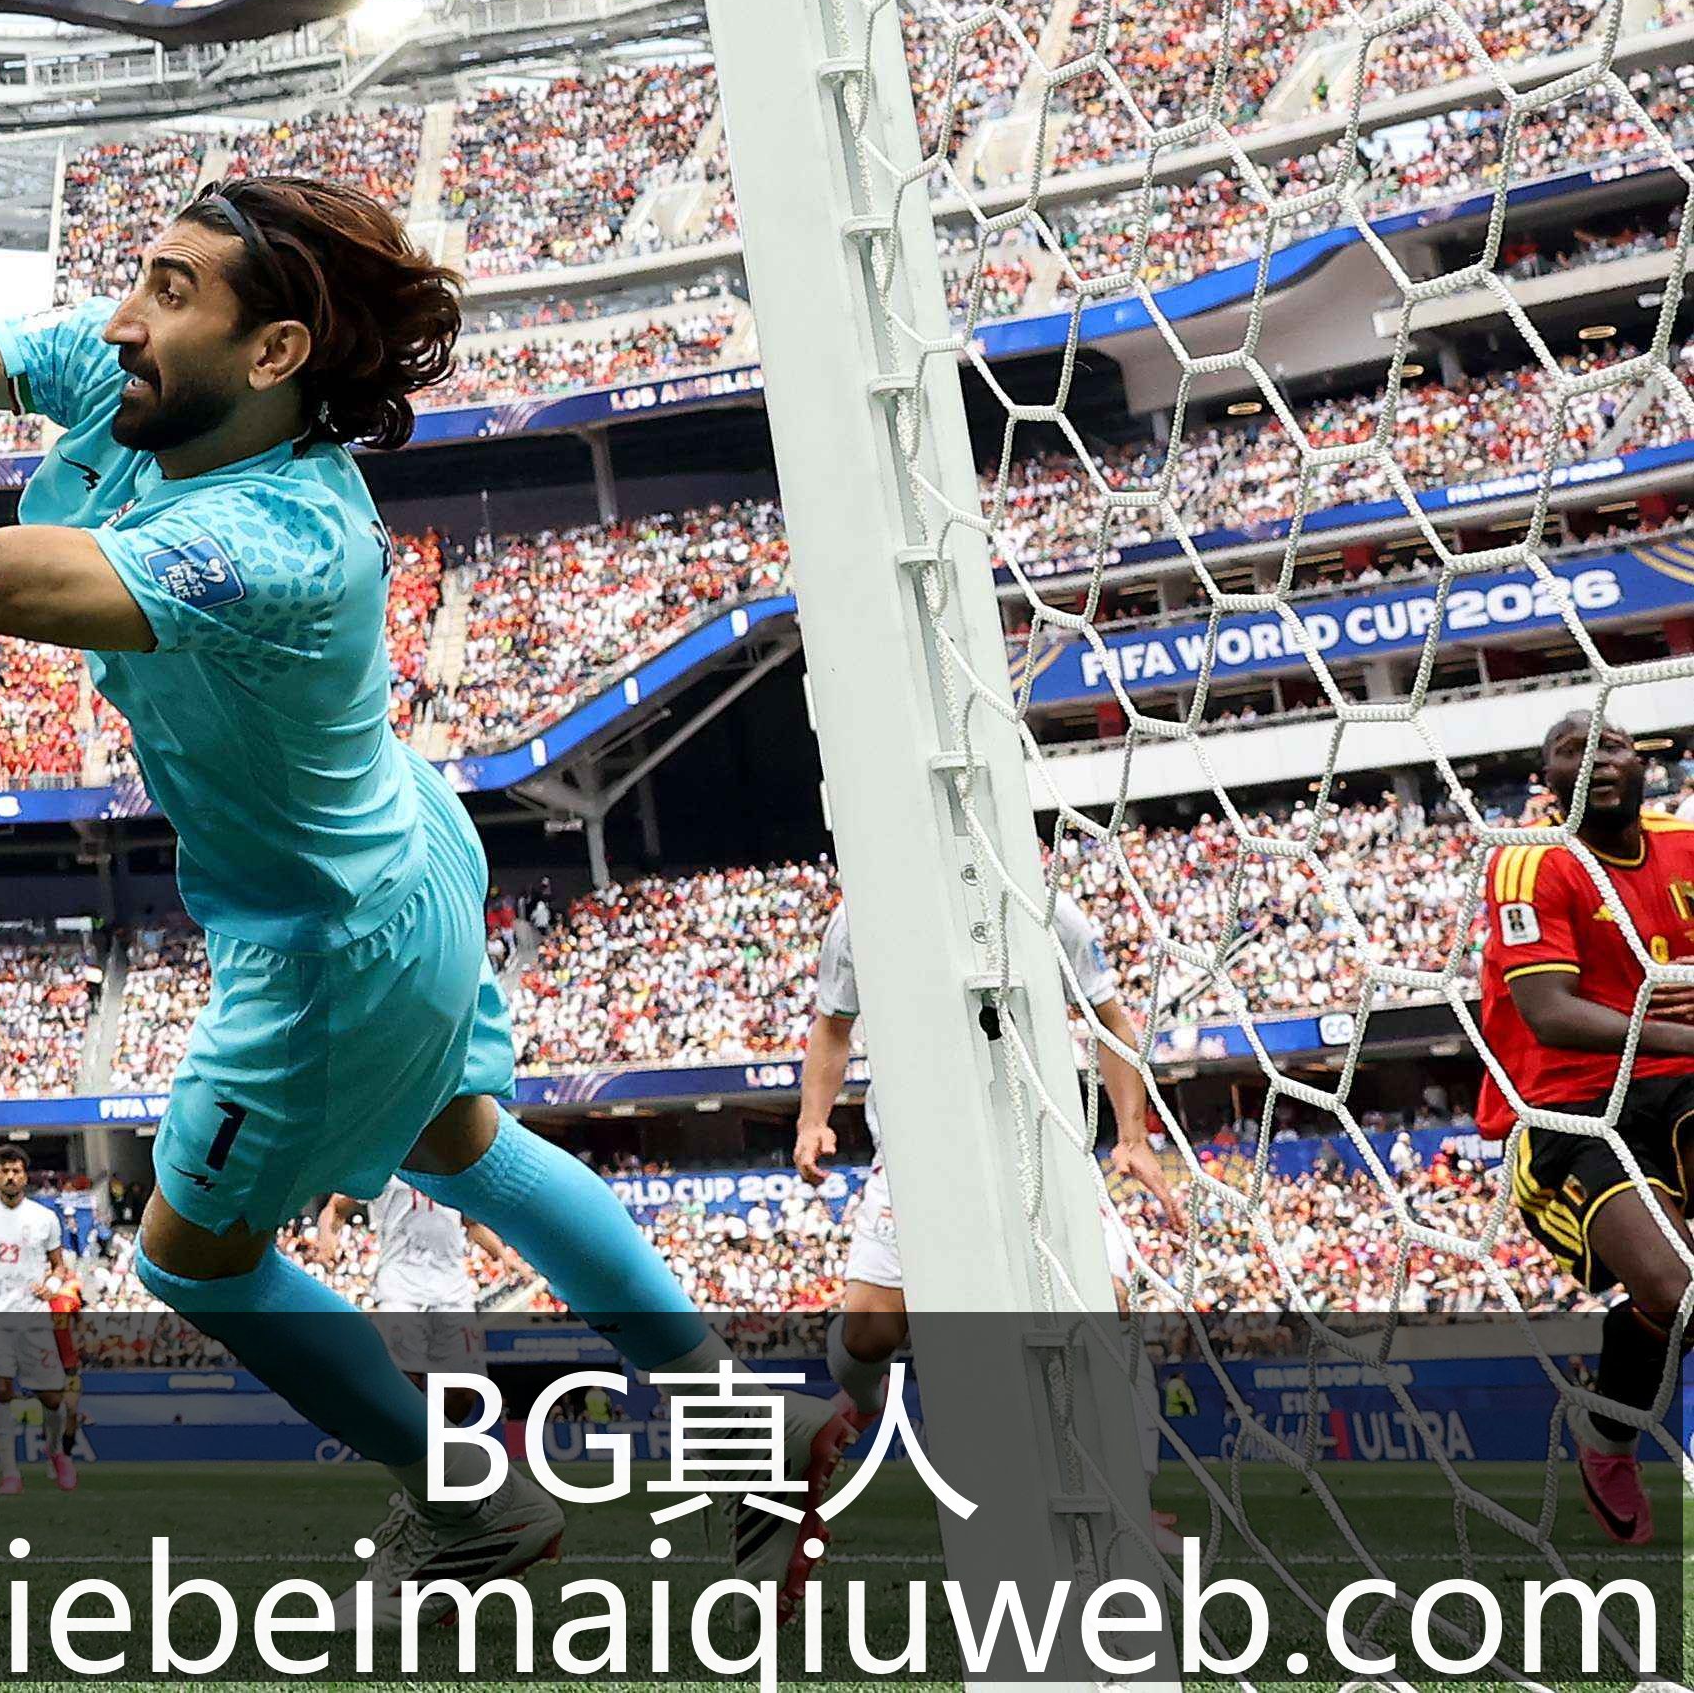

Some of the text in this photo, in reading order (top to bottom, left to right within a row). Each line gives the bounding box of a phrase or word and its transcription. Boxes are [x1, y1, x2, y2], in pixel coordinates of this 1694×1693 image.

[610, 387, 656, 411] LOS
[1080, 569, 1622, 688] FIFA WORLD CUP 2026
[745, 1065, 796, 1088] LOS
[674, 1177, 735, 1204] CUP
[1352, 1409, 1477, 1461] ULTRA
